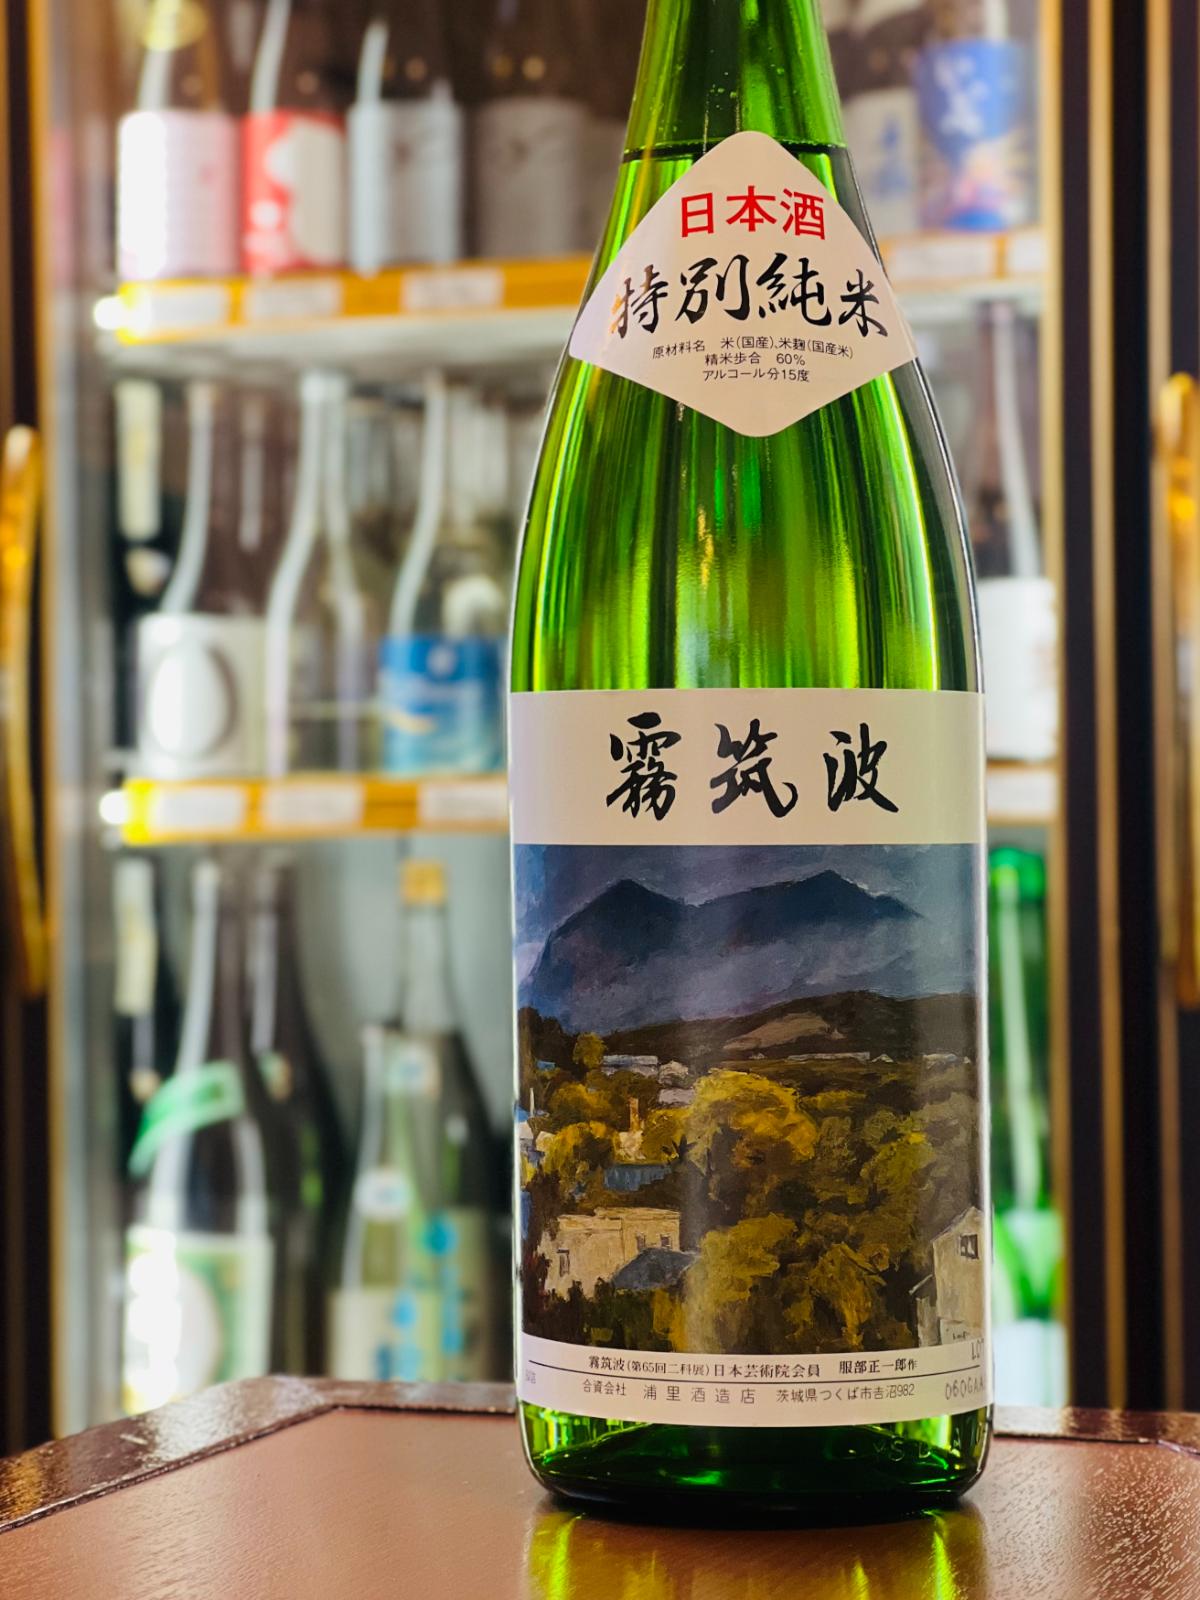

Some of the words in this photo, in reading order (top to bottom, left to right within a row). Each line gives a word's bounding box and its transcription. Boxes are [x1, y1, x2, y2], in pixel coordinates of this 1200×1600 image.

[680, 185, 826, 240] 日本酒
[609, 252, 888, 338] 特別純米
[652, 340, 706, 359] 原材料名
[704, 352, 762, 366] 精米歩合
[776, 353, 806, 366] 60%
[703, 367, 810, 383] アルコール分15度
[606, 712, 899, 821] 霧筑波
[838, 1357, 918, 1375] 服部正一郎作
[582, 1378, 627, 1396] 合資会社
